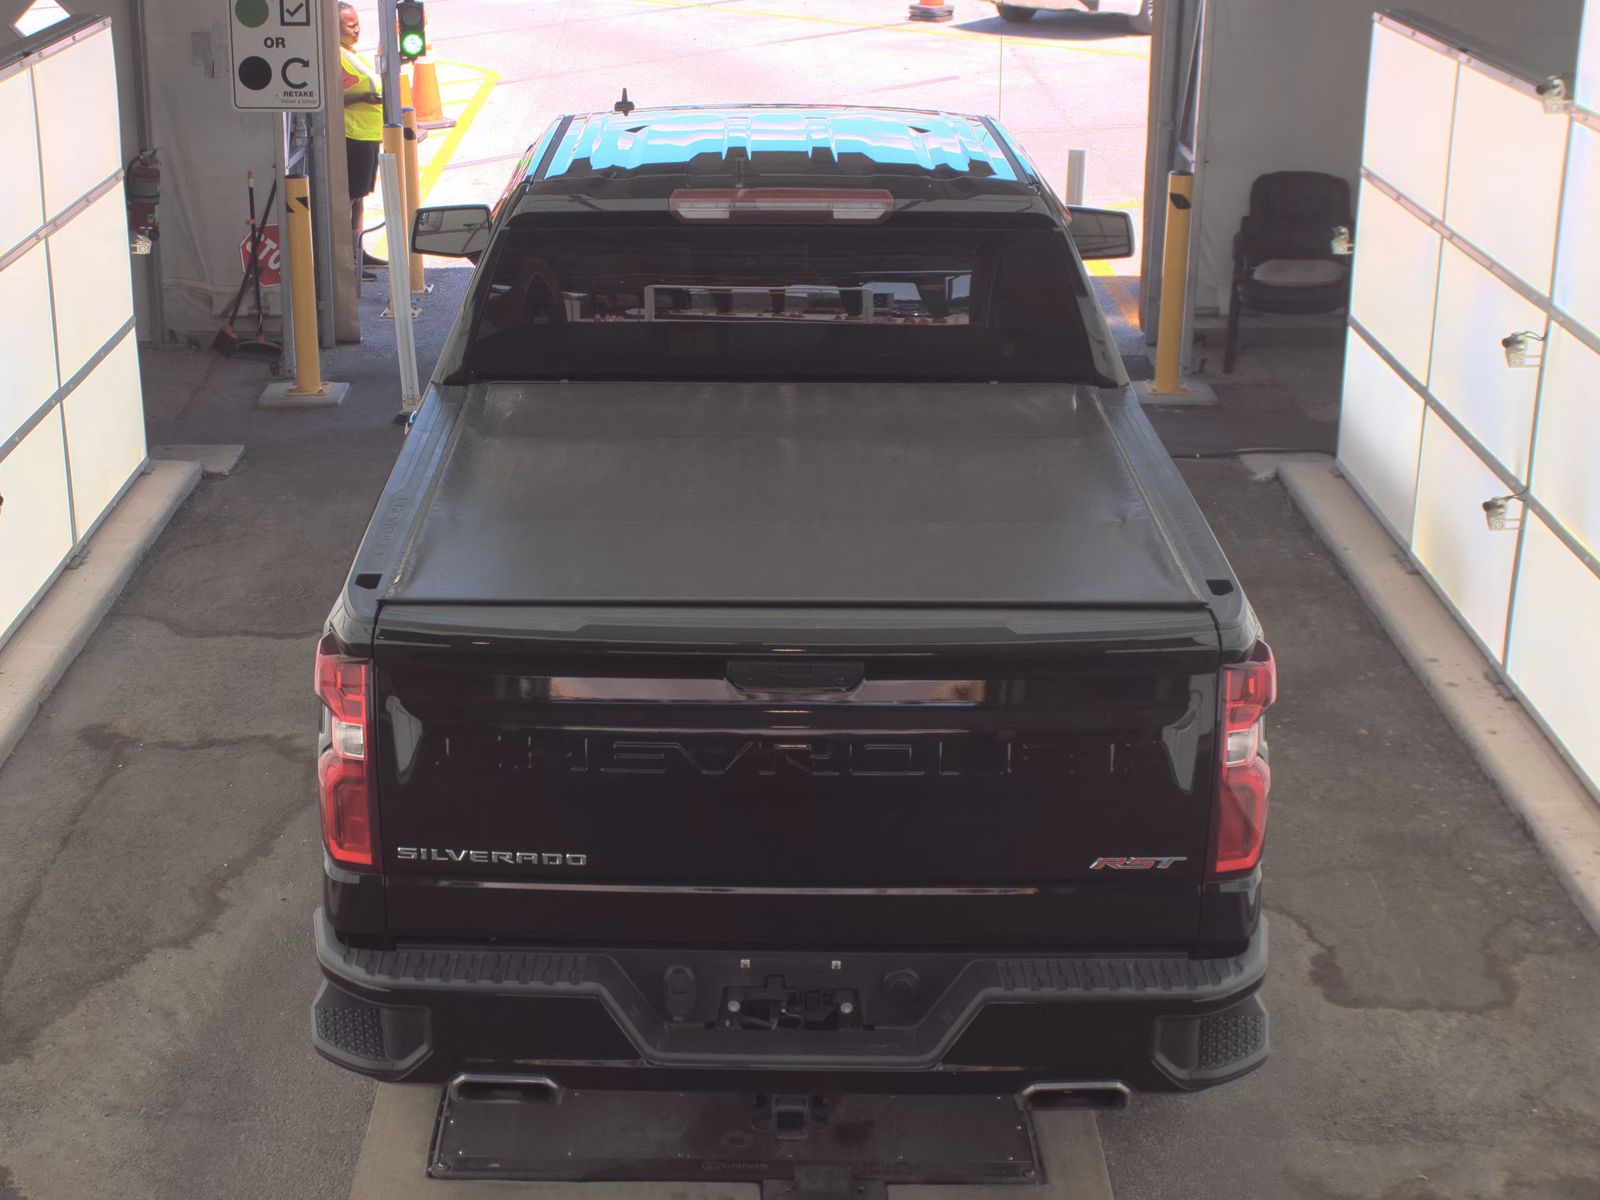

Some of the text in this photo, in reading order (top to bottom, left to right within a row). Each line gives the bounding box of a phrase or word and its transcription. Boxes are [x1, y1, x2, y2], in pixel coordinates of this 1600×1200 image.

[263, 36, 286, 49] OR
[246, 231, 281, 270] TO
[396, 846, 588, 867] SILVERADO
[1089, 856, 1188, 870] RST
